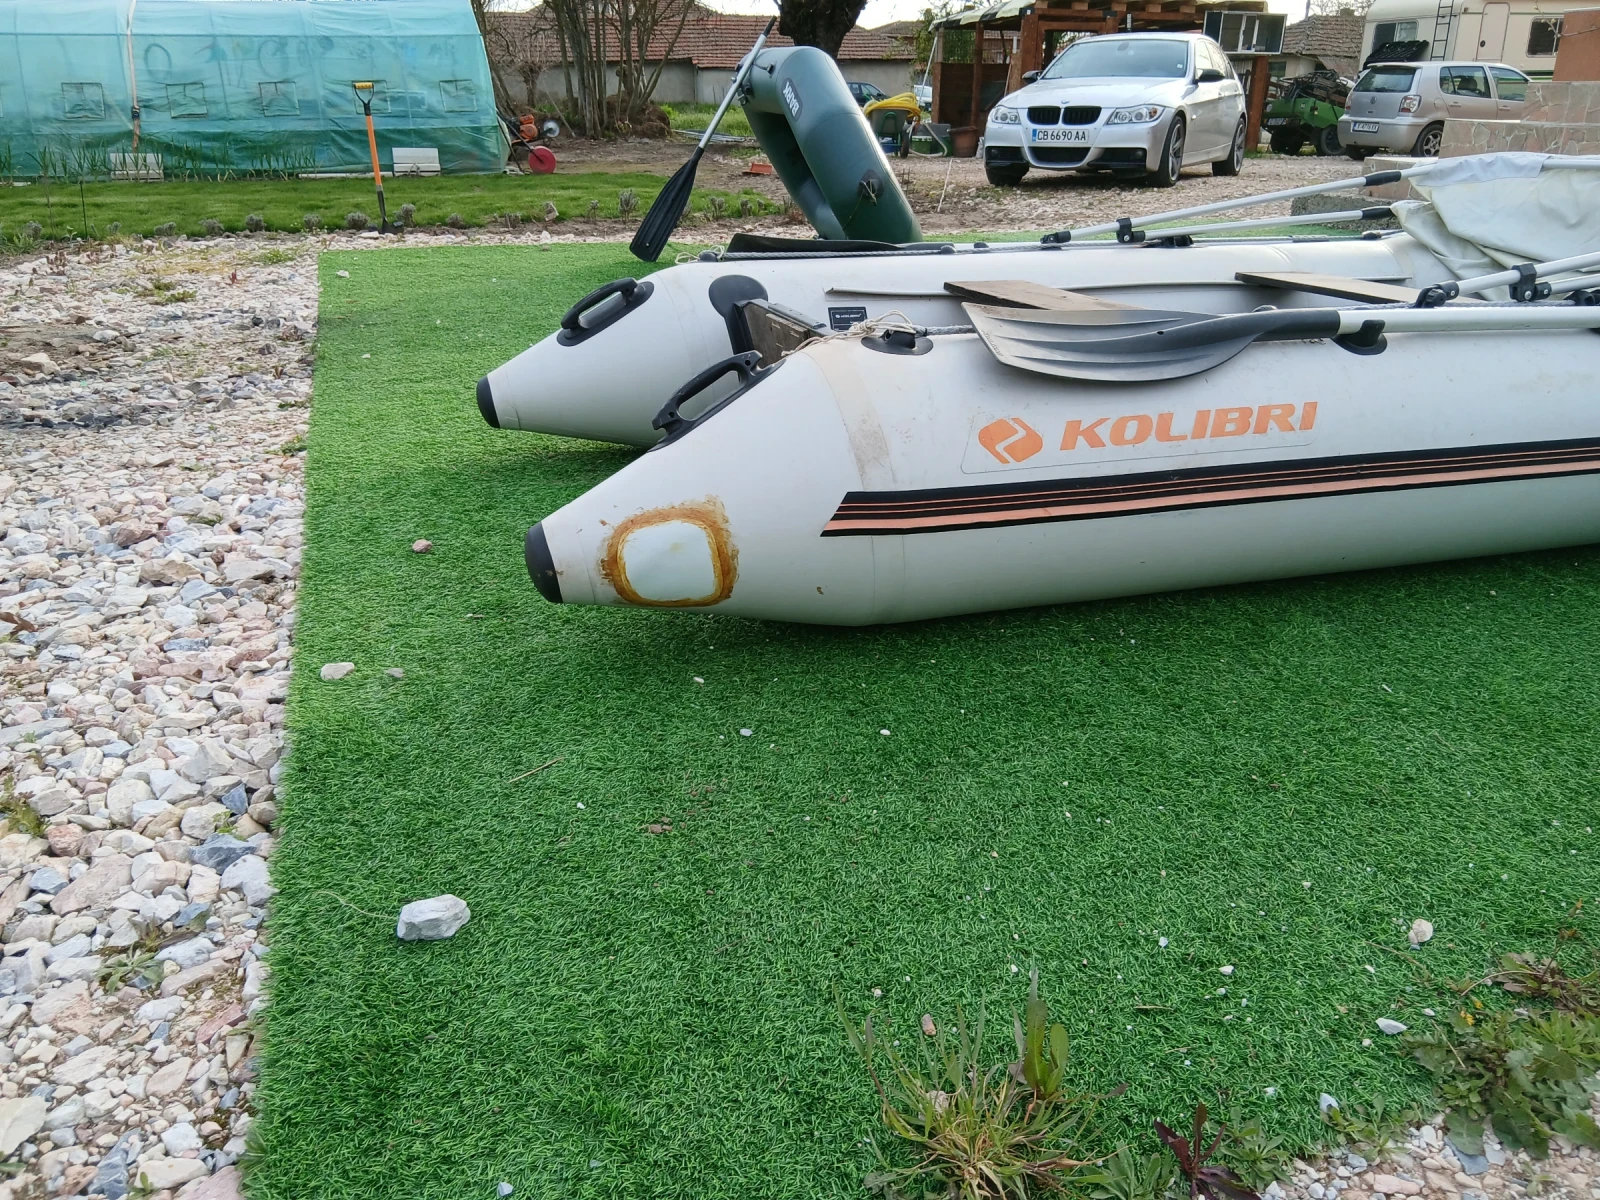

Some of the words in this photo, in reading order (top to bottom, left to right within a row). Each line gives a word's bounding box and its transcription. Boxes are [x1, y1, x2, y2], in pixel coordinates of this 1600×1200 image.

[783, 81, 799, 117] BARK
[1037, 130, 1048, 141] CB
[1050, 130, 1072, 141] 6690
[1074, 130, 1086, 141] AA
[1060, 401, 1318, 450] KOLIBRI
